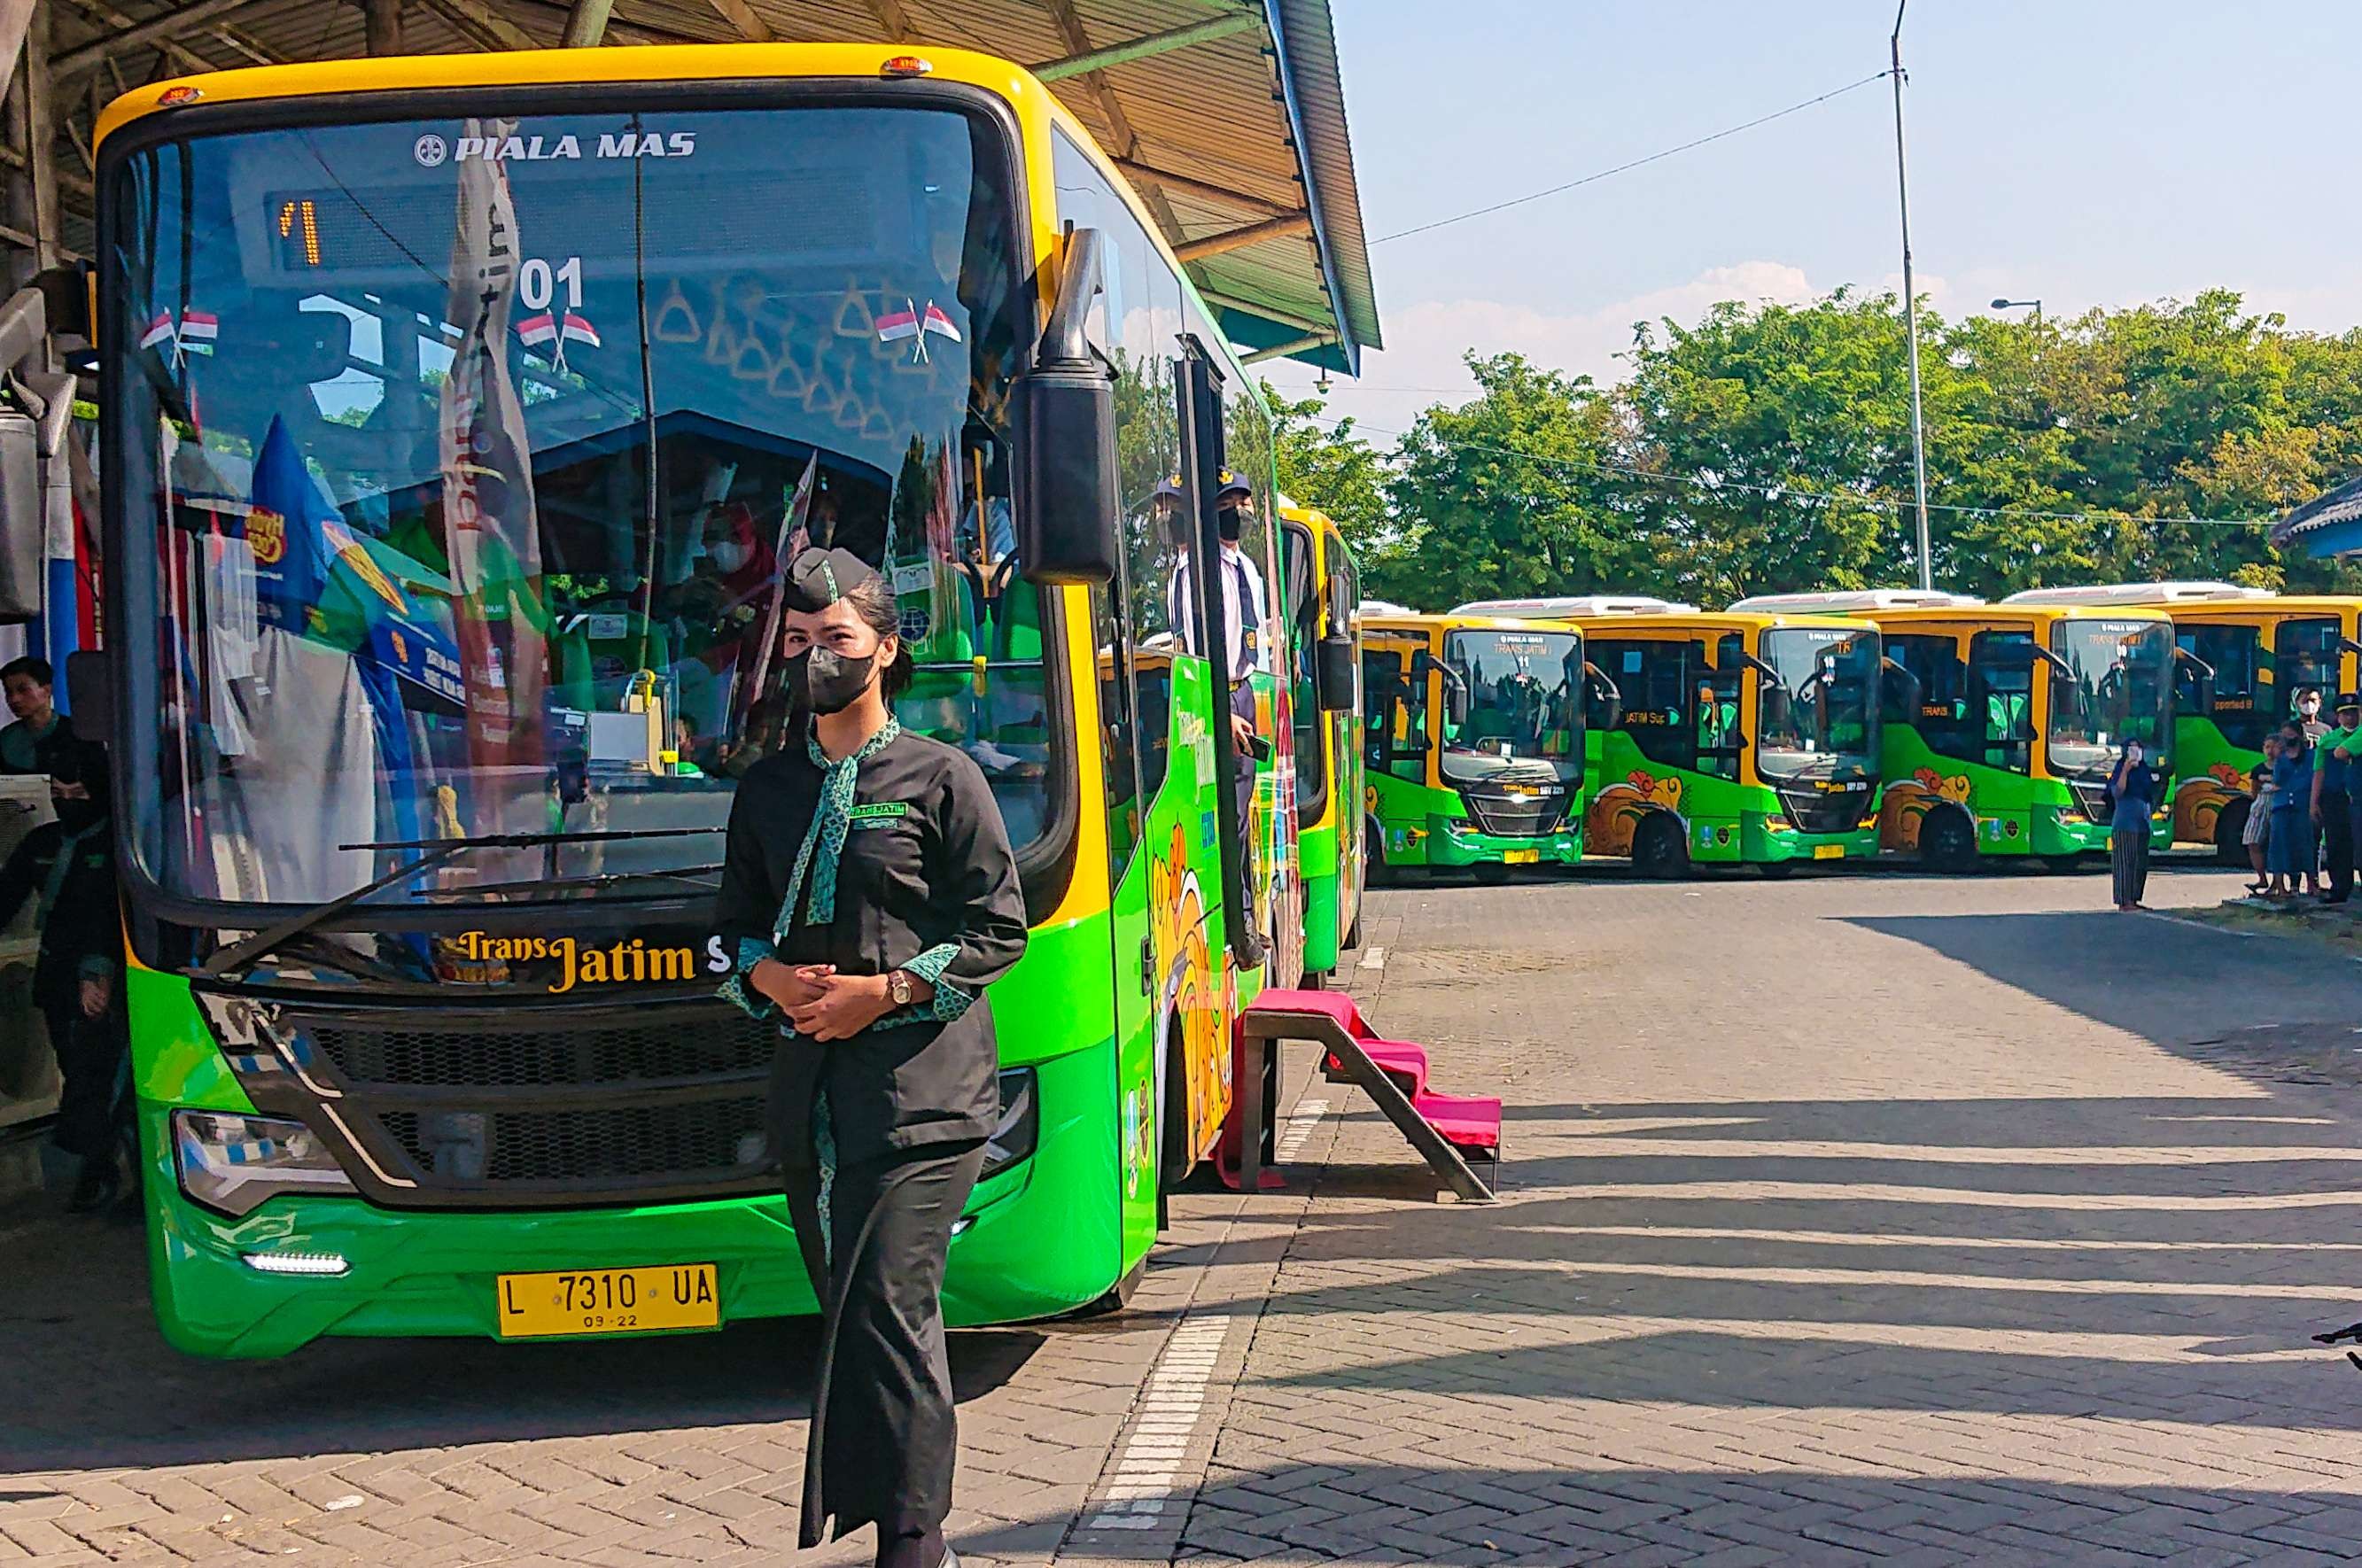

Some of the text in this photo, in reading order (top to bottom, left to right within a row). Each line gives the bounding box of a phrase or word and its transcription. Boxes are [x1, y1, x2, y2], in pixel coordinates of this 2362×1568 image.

[455, 133, 696, 162] PIALA MAS
[520, 257, 582, 310] 01
[458, 930, 548, 961] Trans
[548, 936, 696, 994] Jatim
[506, 1269, 712, 1315] L 7310 UA
